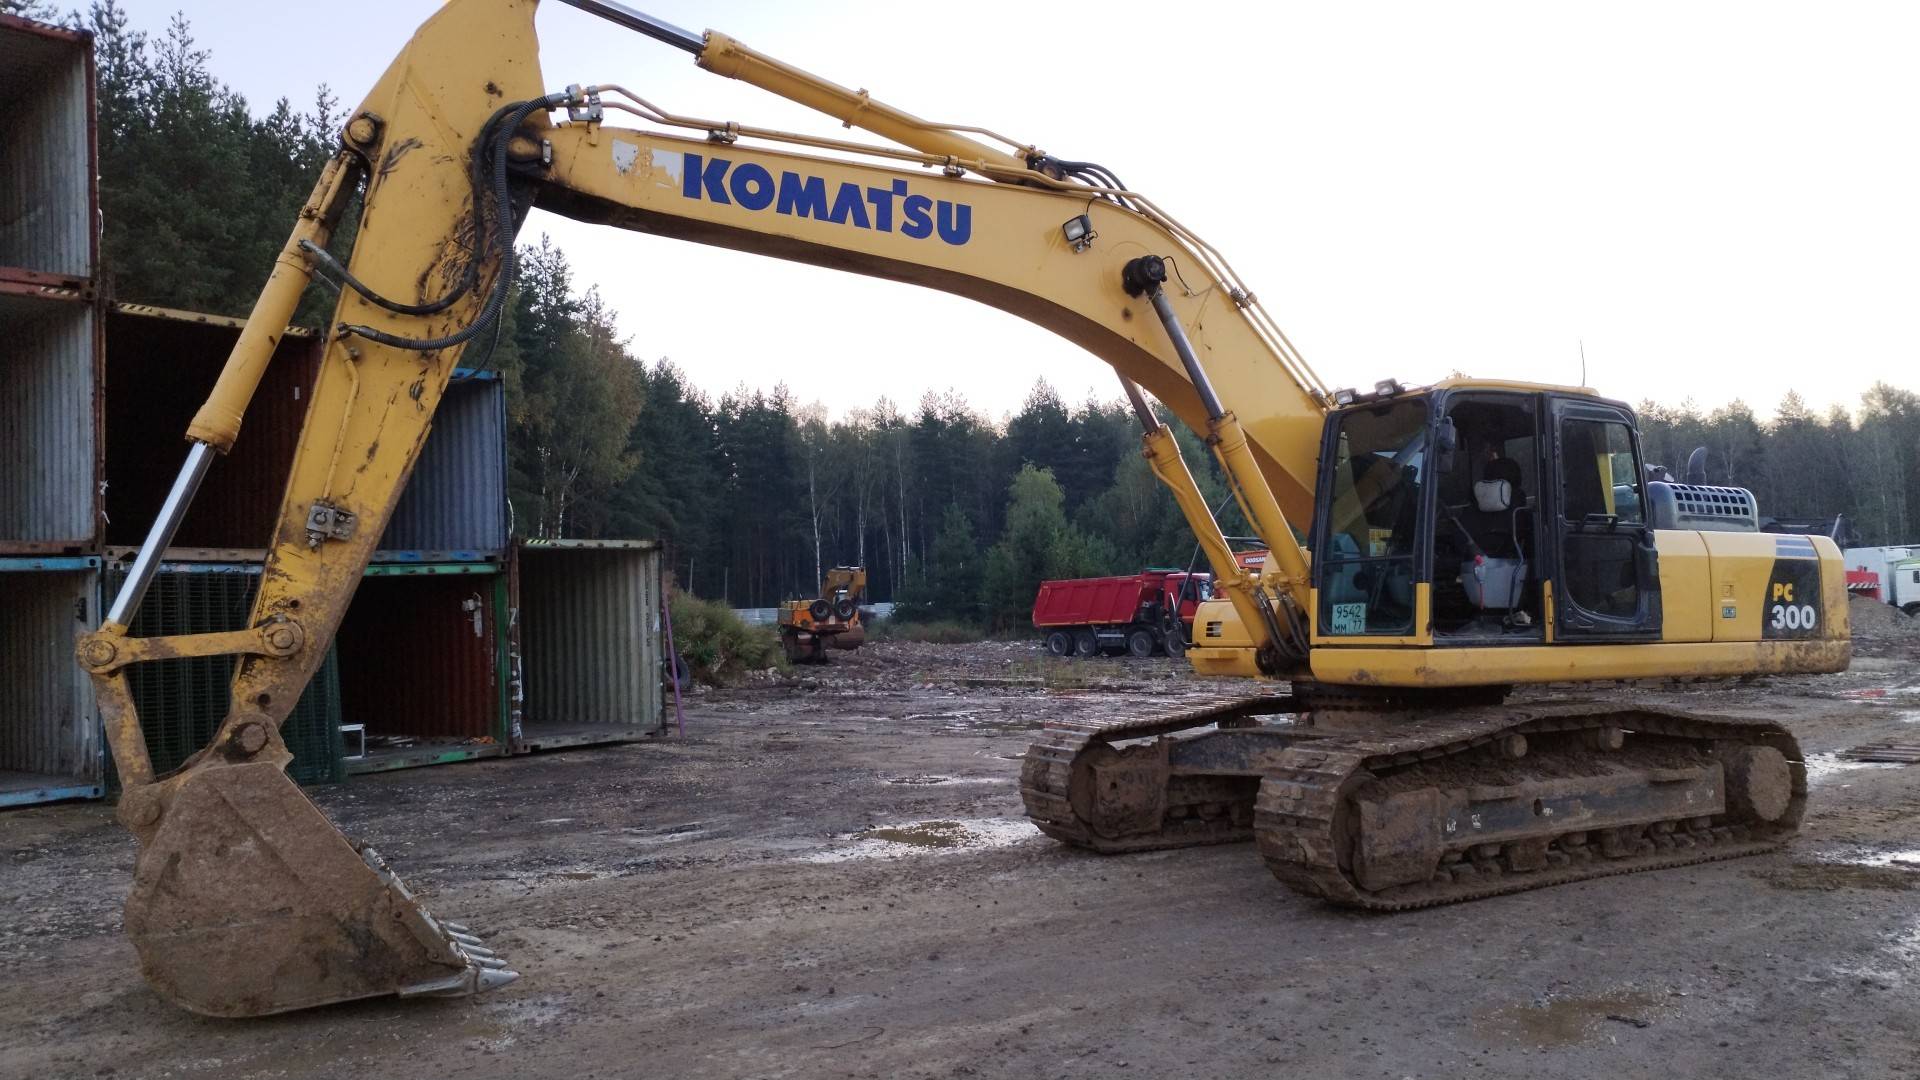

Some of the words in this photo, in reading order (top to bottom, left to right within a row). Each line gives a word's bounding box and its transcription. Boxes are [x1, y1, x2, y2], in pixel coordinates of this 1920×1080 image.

[683, 152, 972, 246] KOMATSU
[1773, 583, 1793, 602] PC
[1336, 605, 1361, 619] 9542
[1771, 604, 1816, 630] 300
